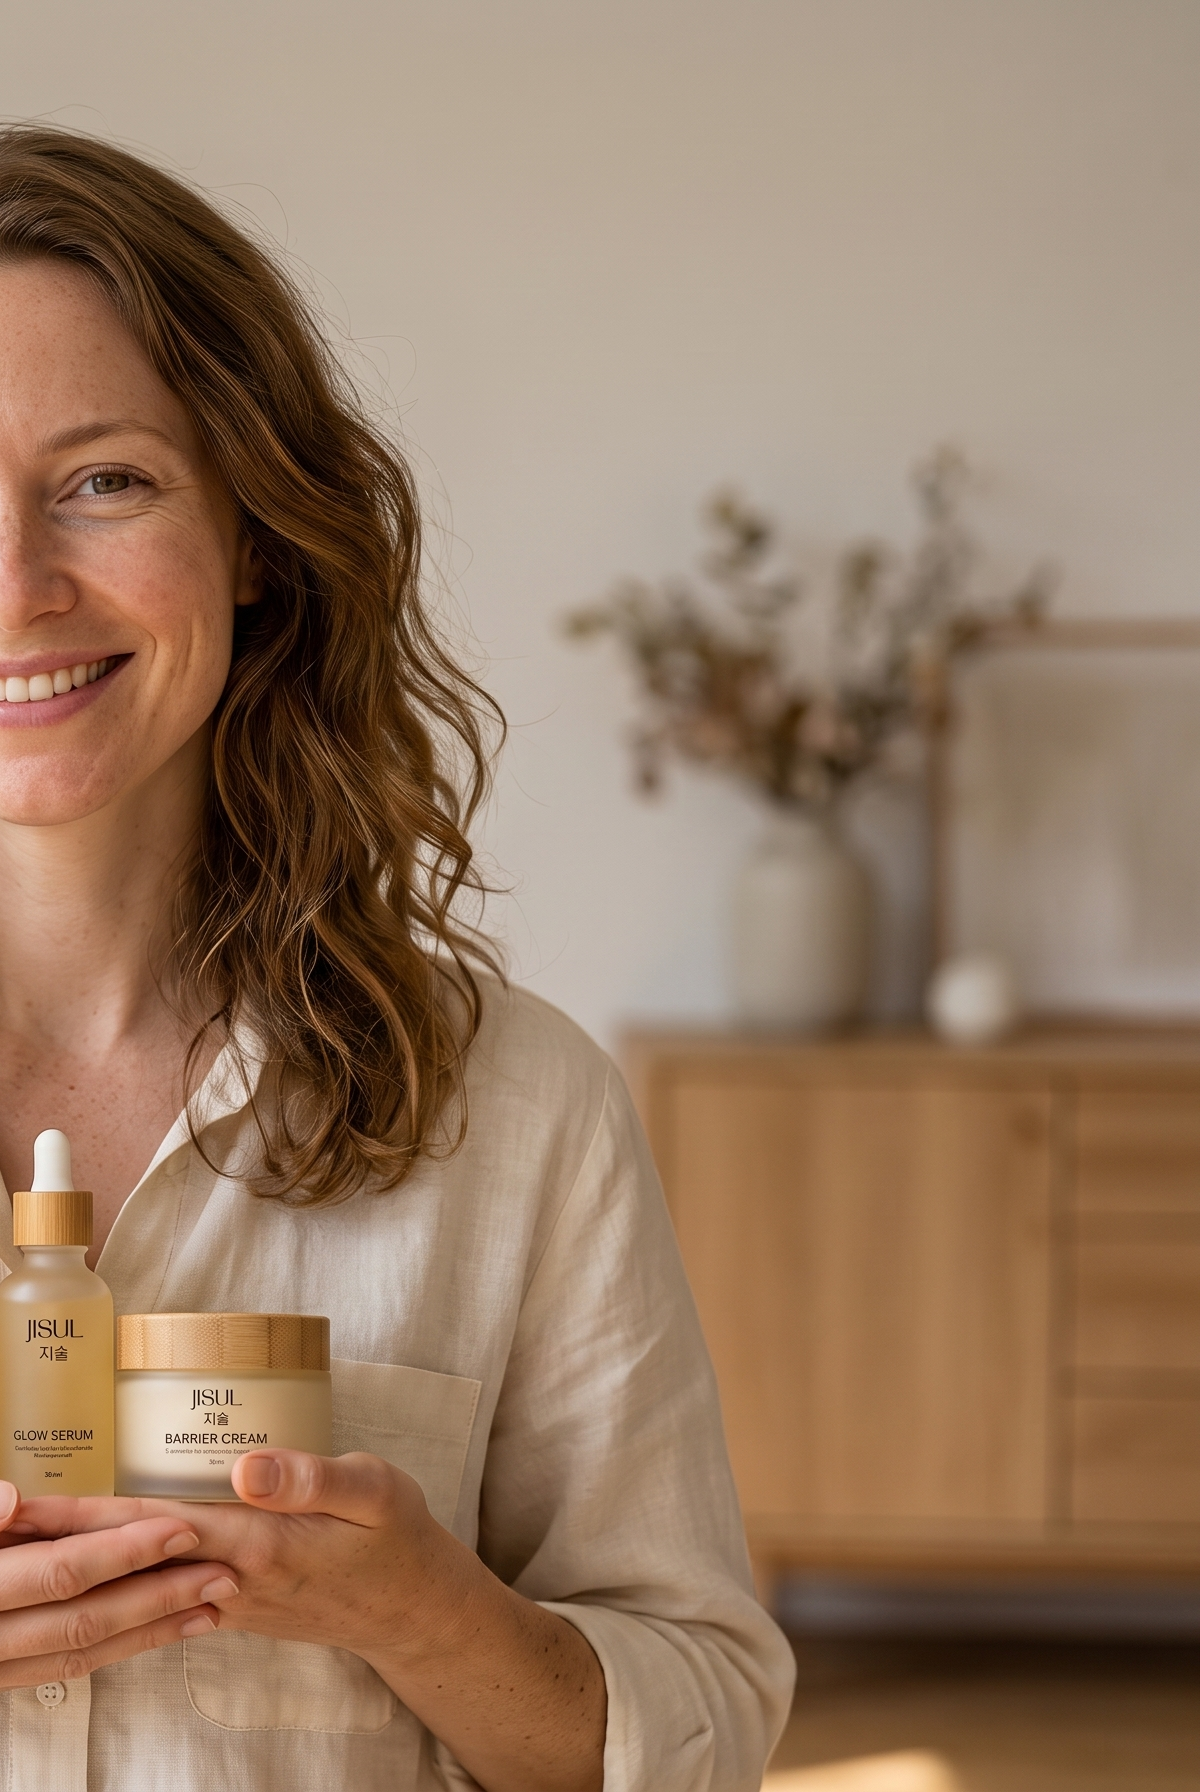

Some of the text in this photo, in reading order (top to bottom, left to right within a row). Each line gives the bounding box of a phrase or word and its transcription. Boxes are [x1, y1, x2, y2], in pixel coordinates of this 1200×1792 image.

[25, 1318, 84, 1343] JISUL
[39, 1345, 68, 1362] 지술
[190, 1388, 242, 1410] JISUL
[13, 1429, 93, 1441] GLOW SERUM
[165, 1433, 268, 1445] BARRIER CREAM
